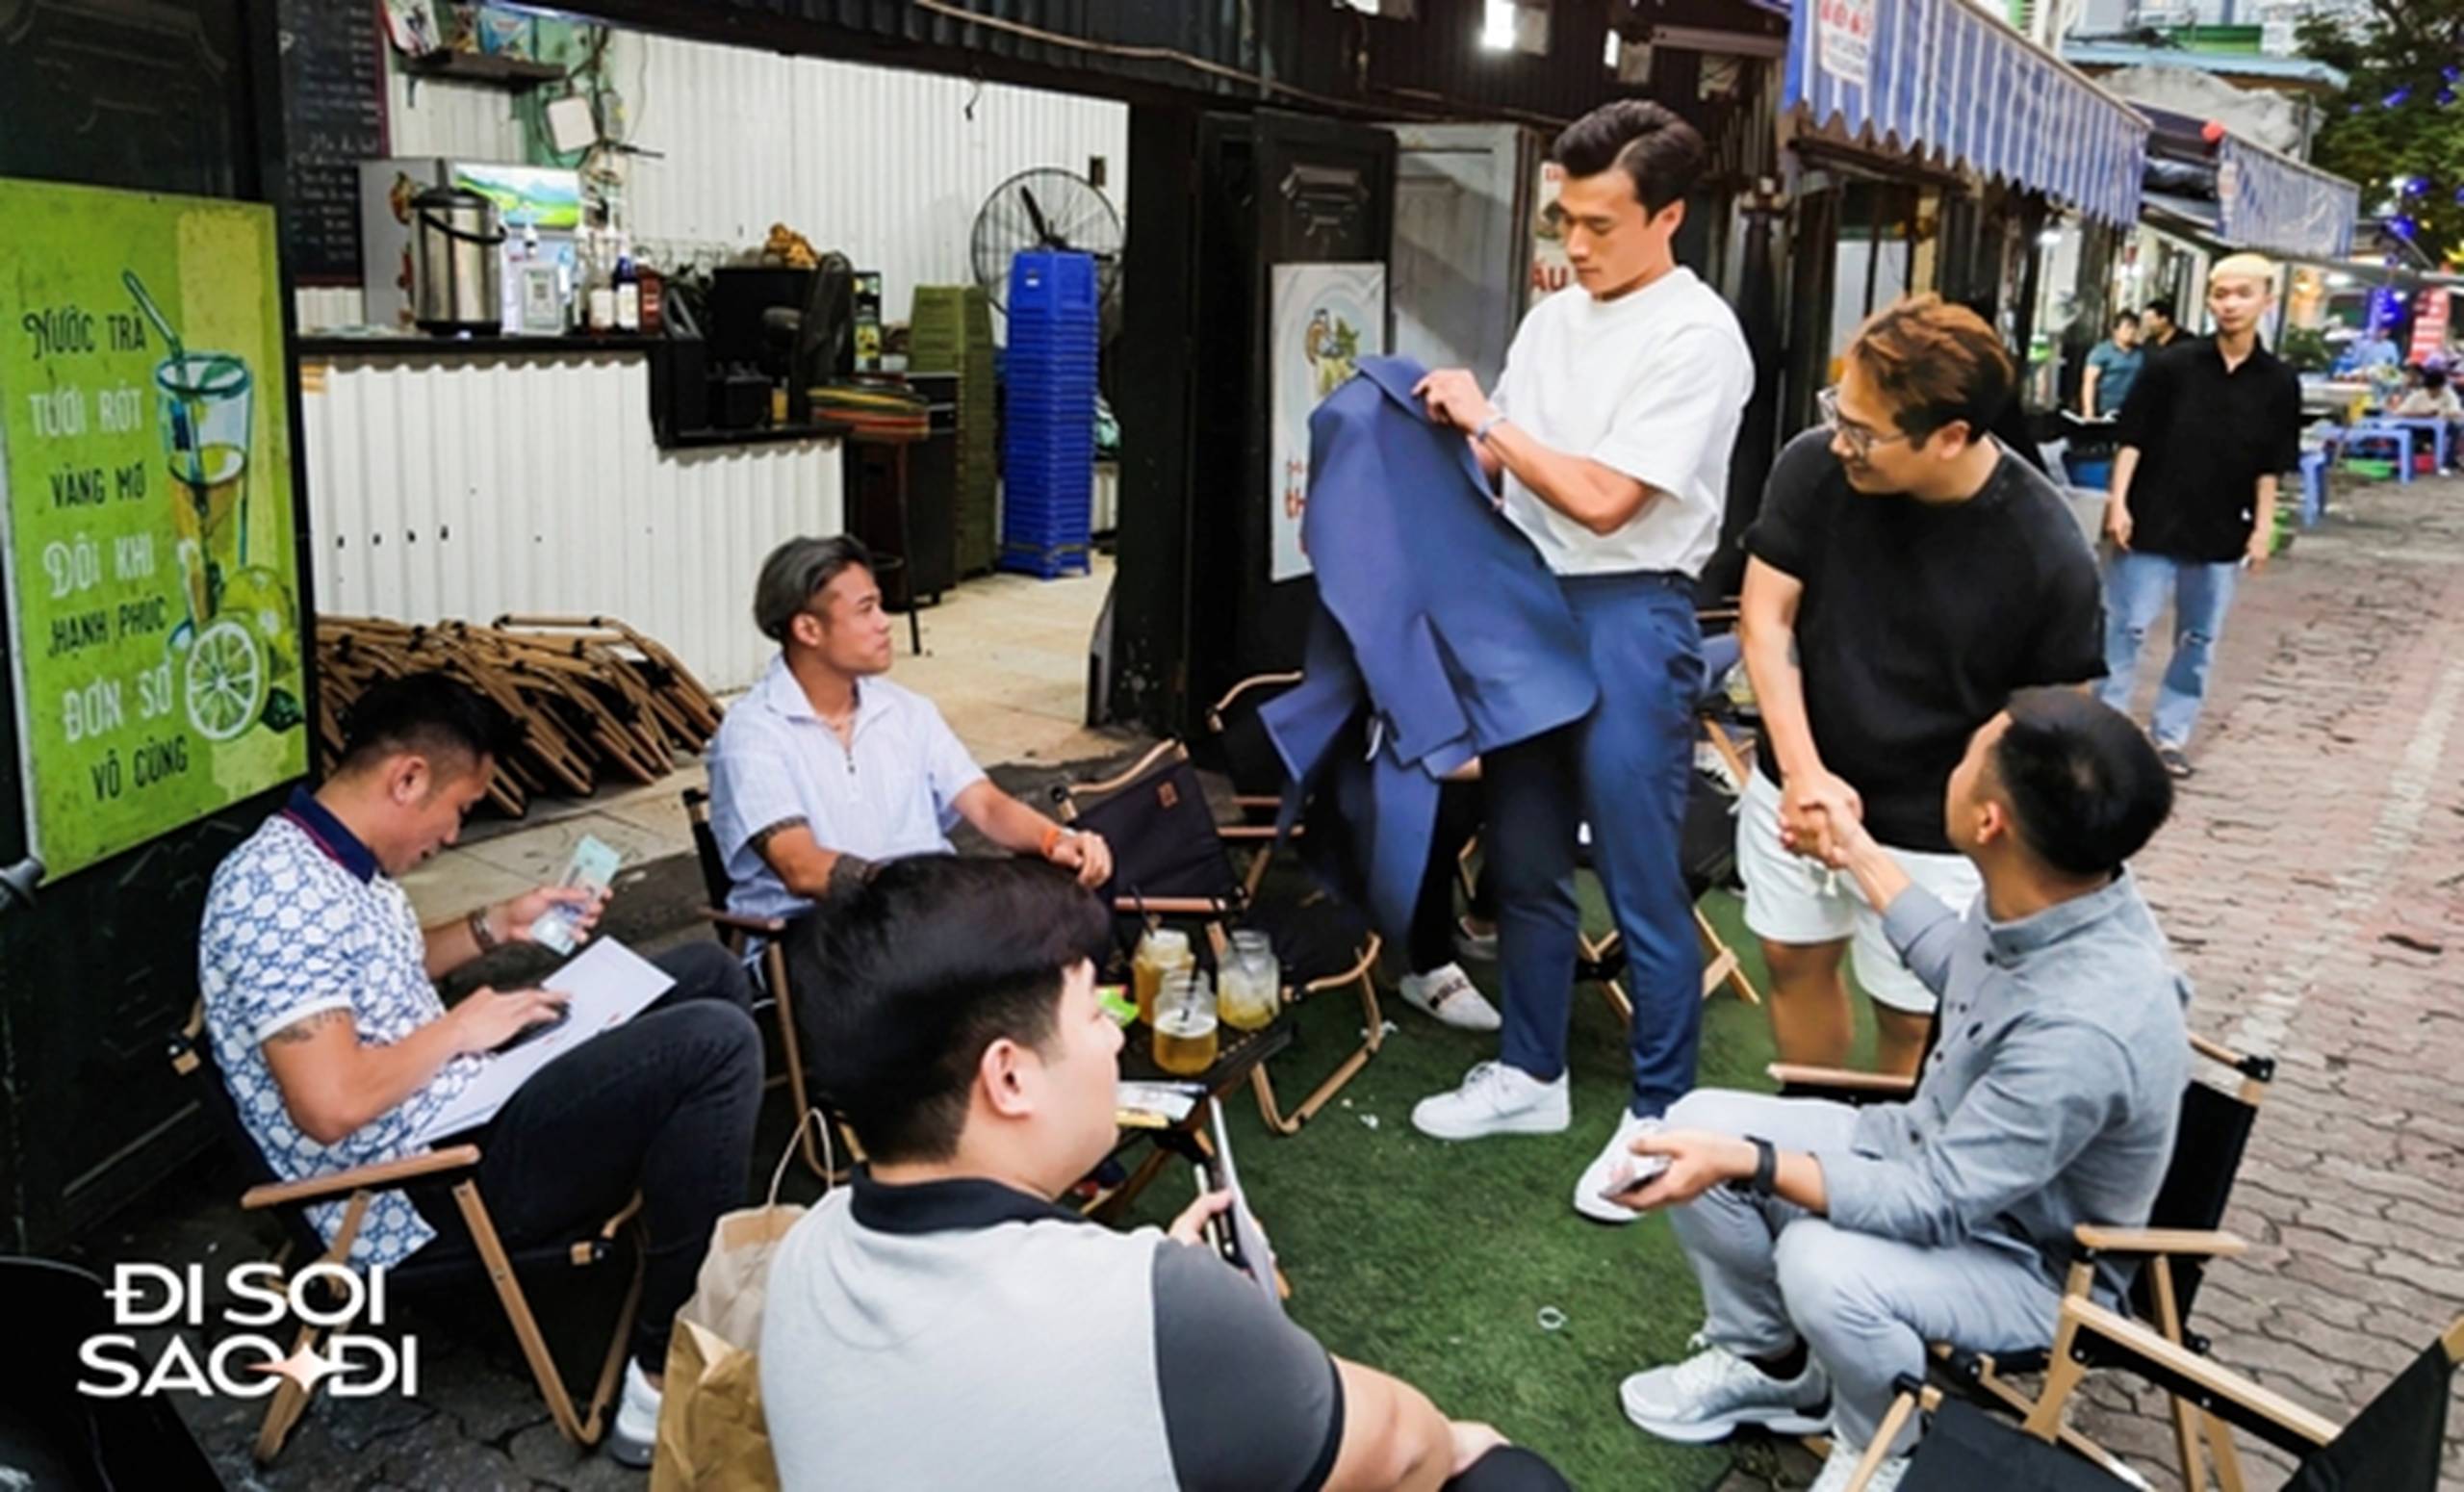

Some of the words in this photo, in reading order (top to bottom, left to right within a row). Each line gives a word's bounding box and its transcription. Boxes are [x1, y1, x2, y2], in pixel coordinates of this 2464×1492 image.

[22, 304, 94, 359] NƯỚC
[49, 461, 106, 507] VÀNG
[43, 532, 101, 598] ĐÔI
[116, 532, 154, 580] KHI
[90, 749, 120, 801] VÔ
[134, 734, 188, 787] CÙNG
